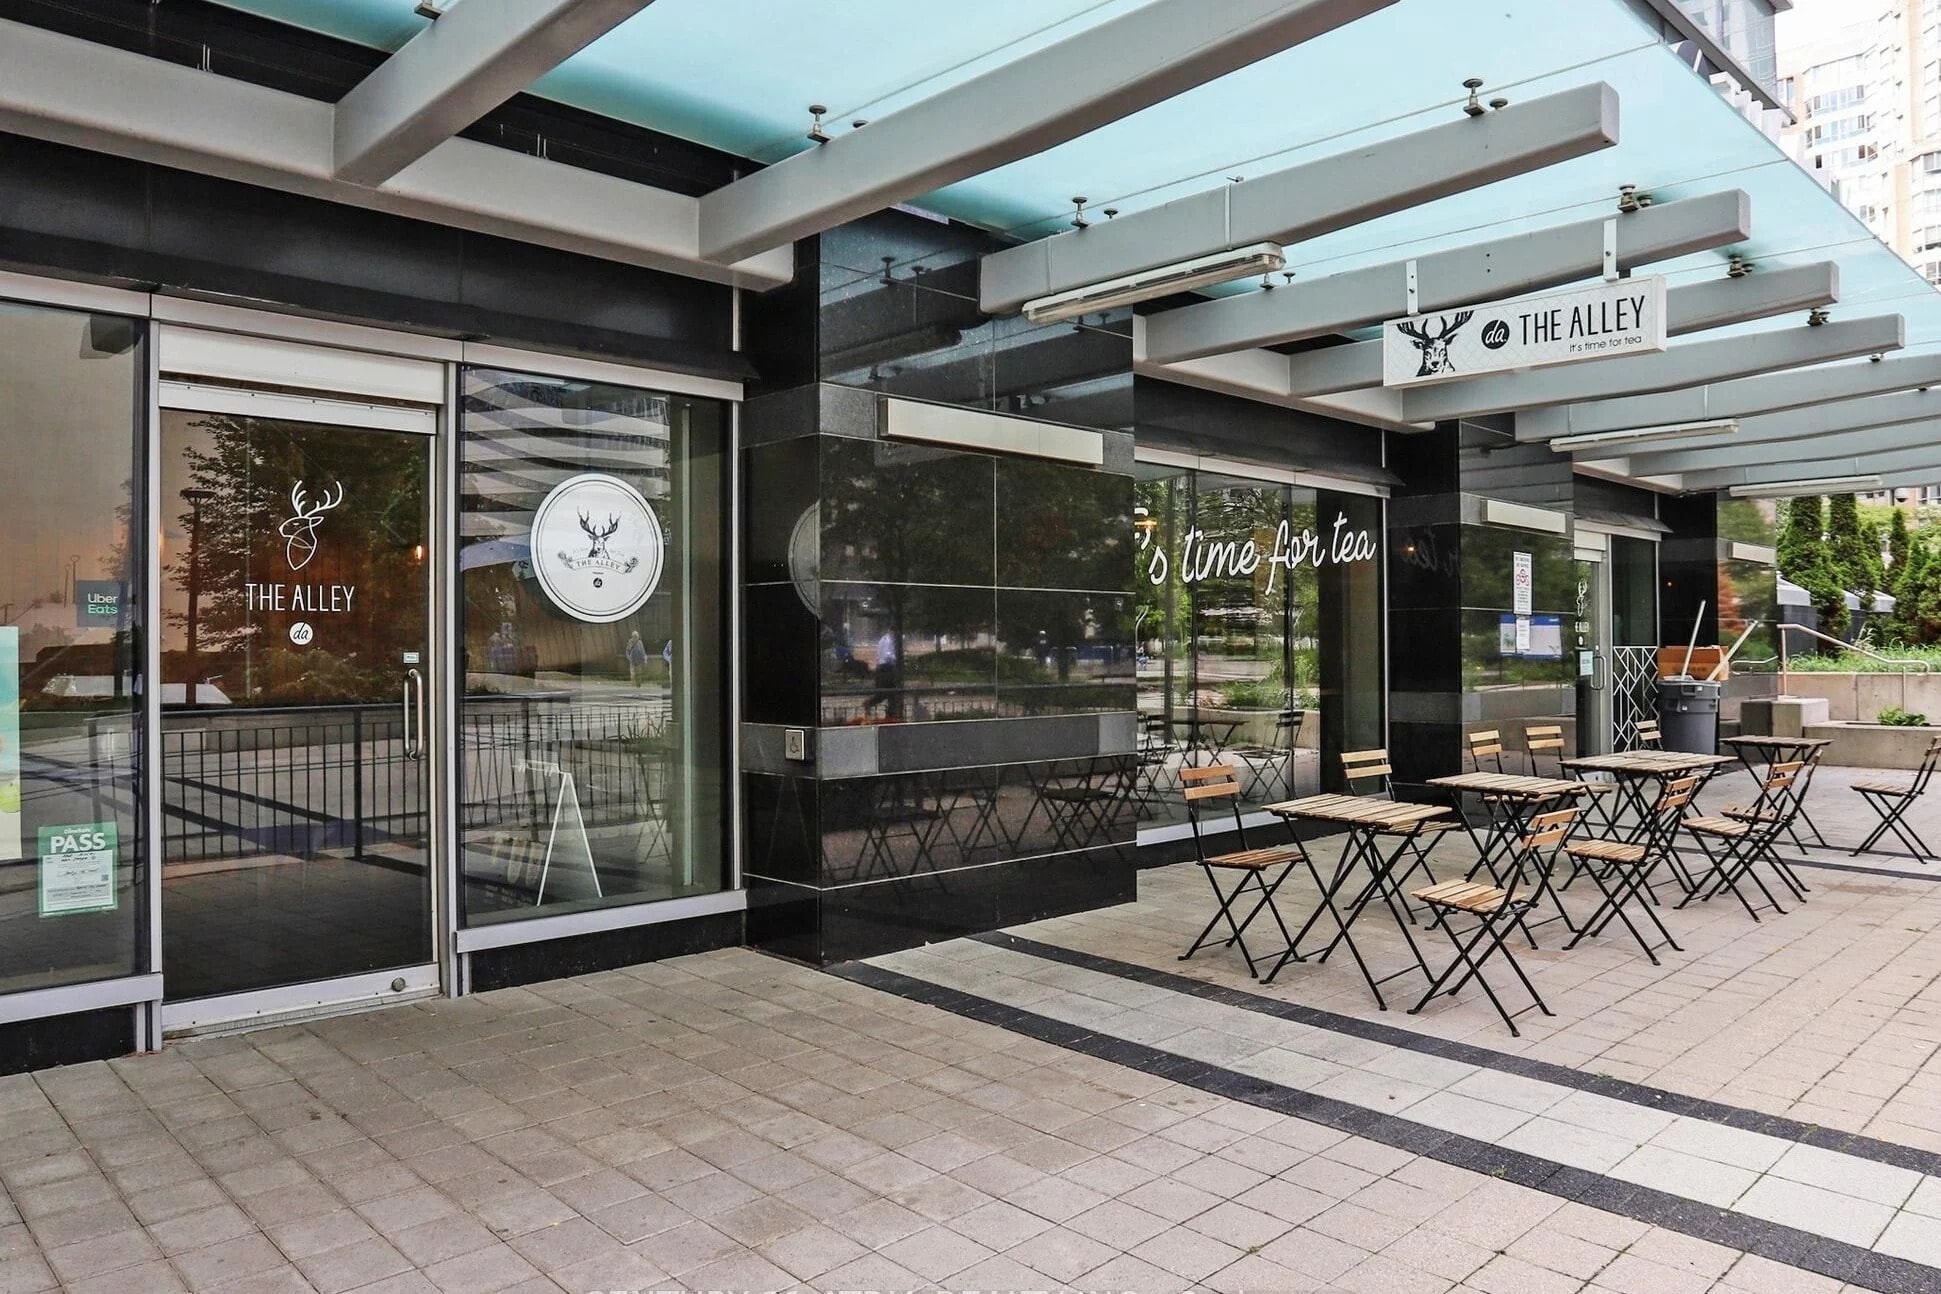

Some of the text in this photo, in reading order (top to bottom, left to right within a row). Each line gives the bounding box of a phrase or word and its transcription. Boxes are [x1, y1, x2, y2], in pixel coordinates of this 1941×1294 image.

[1519, 295, 1646, 346] THE ALLEY
[1585, 340, 1606, 351] time
[1608, 337, 1622, 348] for
[1624, 335, 1643, 345] tea
[1182, 524, 1261, 584] time
[1267, 519, 1326, 596] for
[1331, 510, 1377, 564] tea
[596, 560, 621, 570] ALLEY
[87, 593, 118, 604] Uber
[245, 583, 355, 612] THE ALLEY
[87, 604, 118, 614] Eats
[50, 832, 106, 854] PASS
